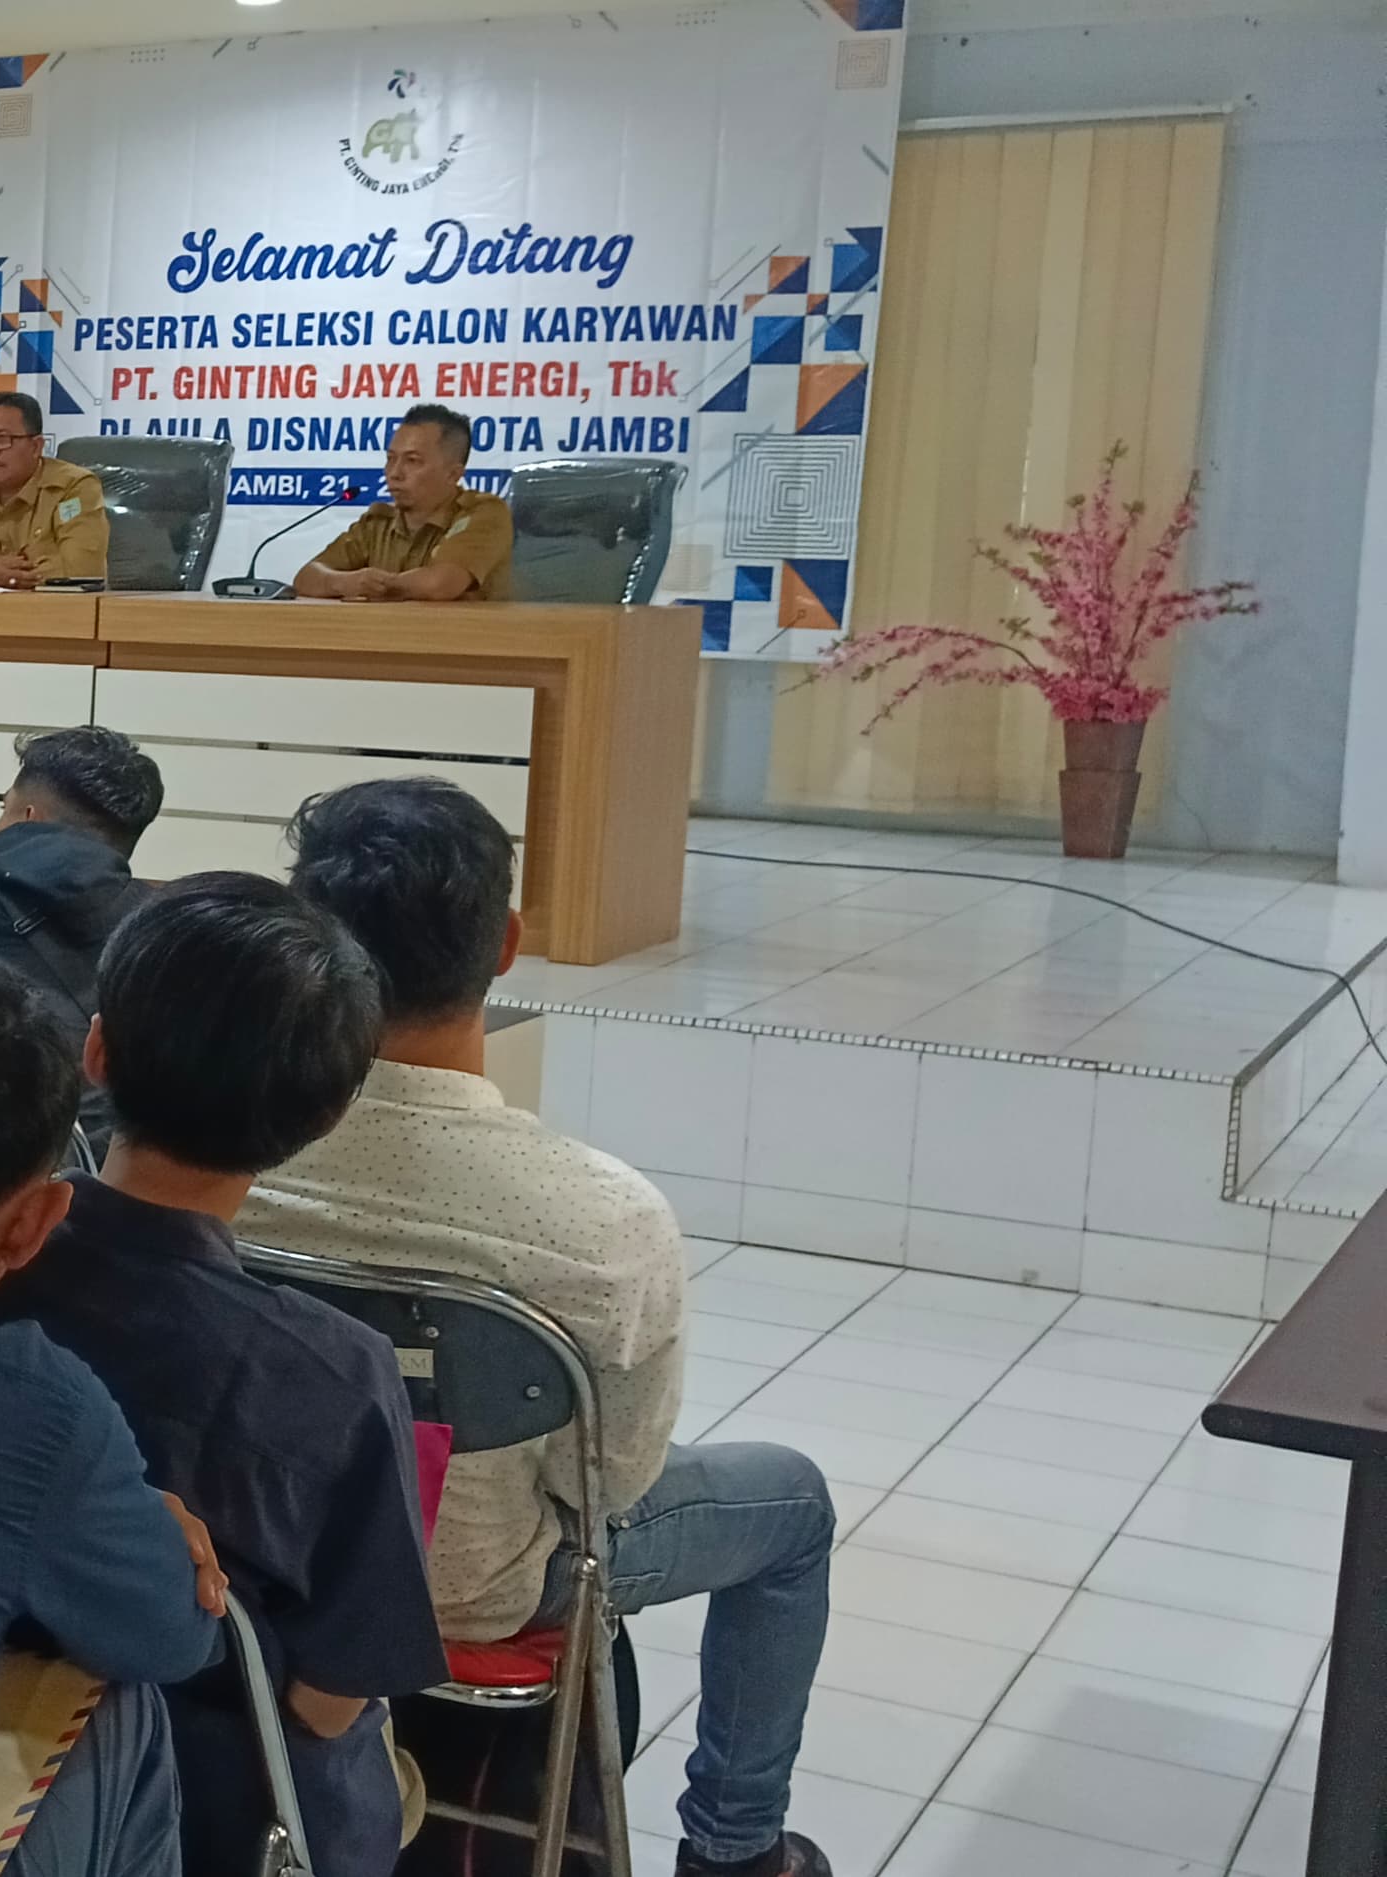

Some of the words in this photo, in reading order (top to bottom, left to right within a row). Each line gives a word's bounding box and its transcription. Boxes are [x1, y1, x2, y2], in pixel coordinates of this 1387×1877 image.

[381, 183, 409, 195] JAYA
[167, 227, 398, 293] Selamat
[405, 218, 634, 289] Datang
[74, 315, 219, 352] PESERTA
[231, 311, 374, 349] SELEKSI
[388, 308, 508, 345] CALON
[522, 304, 738, 342] KARYAWAN
[111, 367, 158, 401] PT.
[172, 364, 318, 400] GINTING
[330, 362, 421, 399] JAYA
[435, 361, 591, 403] ENERGI,
[607, 360, 679, 398] Tbk
[247, 416, 404, 451] DISNAKE
[471, 416, 544, 452] OTA
[558, 416, 690, 453] JAMBI
[227, 474, 310, 500] AMBI,
